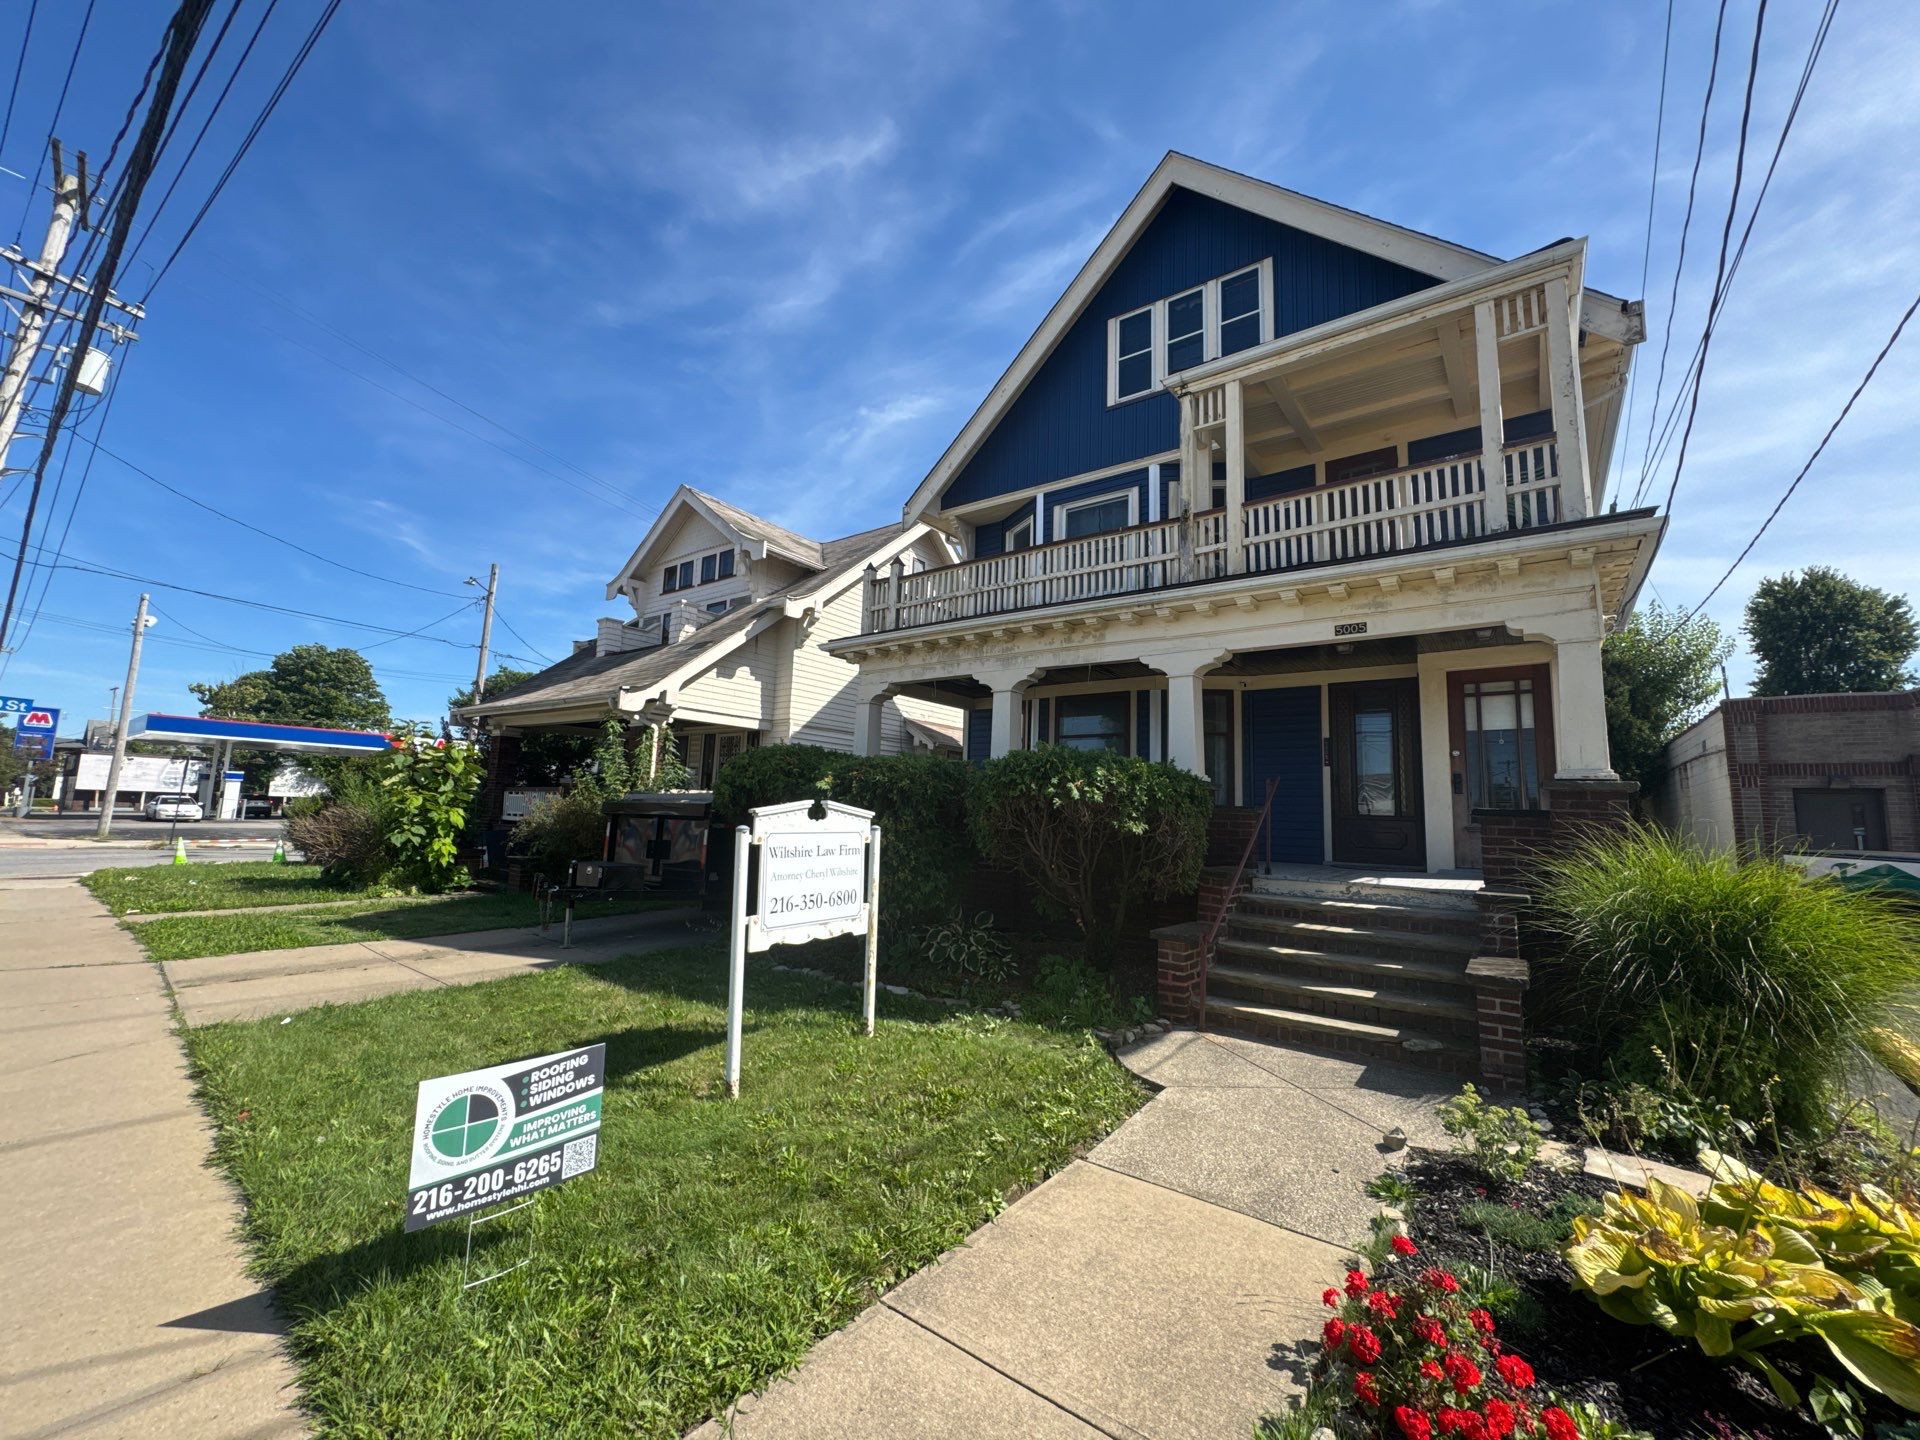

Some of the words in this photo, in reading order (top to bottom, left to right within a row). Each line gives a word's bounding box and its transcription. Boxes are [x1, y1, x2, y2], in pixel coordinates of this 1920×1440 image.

[1336, 623, 1366, 635] 5005
[5, 700, 27, 712] St
[769, 846, 813, 859] Wiltshire
[816, 845, 836, 857] Law
[839, 844, 861, 856] Firm
[770, 871, 804, 882] Attorney
[805, 867, 828, 880] Cheryl
[829, 866, 859, 877] Wiltshire
[769, 888, 857, 914] 216-350-6800
[530, 1054, 589, 1083] ROOFING
[529, 1070, 575, 1095] SIDING
[529, 1074, 596, 1107] WINDOWS
[422, 1096, 452, 1141] HOMESTYLE
[451, 1085, 475, 1099] HOME
[475, 1085, 508, 1122] IMPROVEMENTS
[523, 1104, 587, 1132] IMPROVING
[509, 1127, 546, 1148] WHAT
[547, 1110, 597, 1136] MATTERS
[412, 1150, 562, 1216] 216-200-6265
